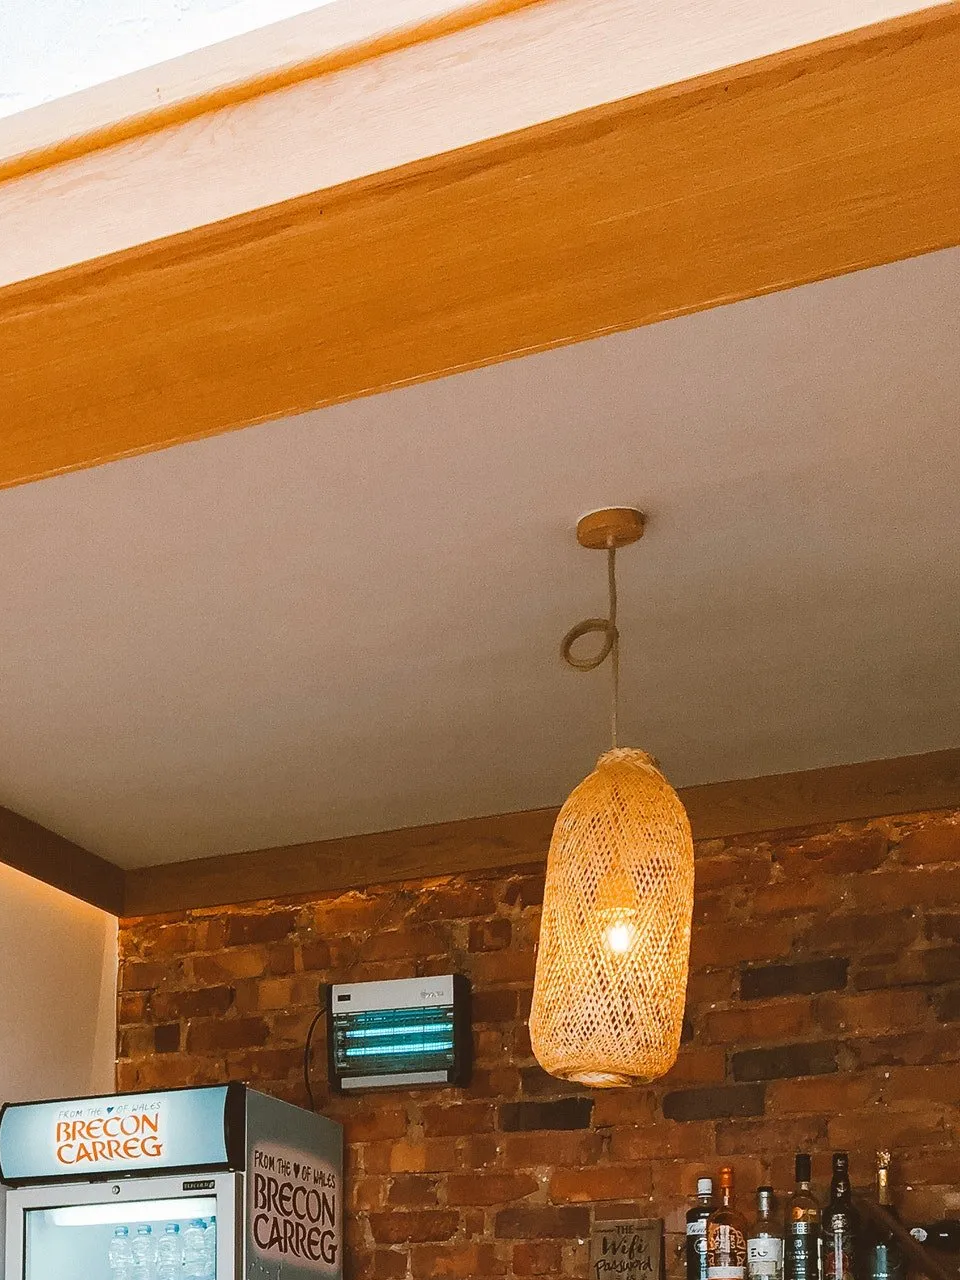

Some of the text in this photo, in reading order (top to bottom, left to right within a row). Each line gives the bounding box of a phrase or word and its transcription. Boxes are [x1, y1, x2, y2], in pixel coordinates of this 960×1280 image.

[58, 1110, 83, 1118] FROM
[87, 1108, 101, 1116] THE
[132, 1101, 161, 1111] WALES
[56, 1113, 159, 1142] BRECON
[56, 1135, 163, 1164] CARREG
[254, 1150, 336, 1189] FROM THE OF WALES
[254, 1173, 336, 1228] BRECON
[253, 1213, 338, 1265] CARREG
[615, 1225, 635, 1234] THE
